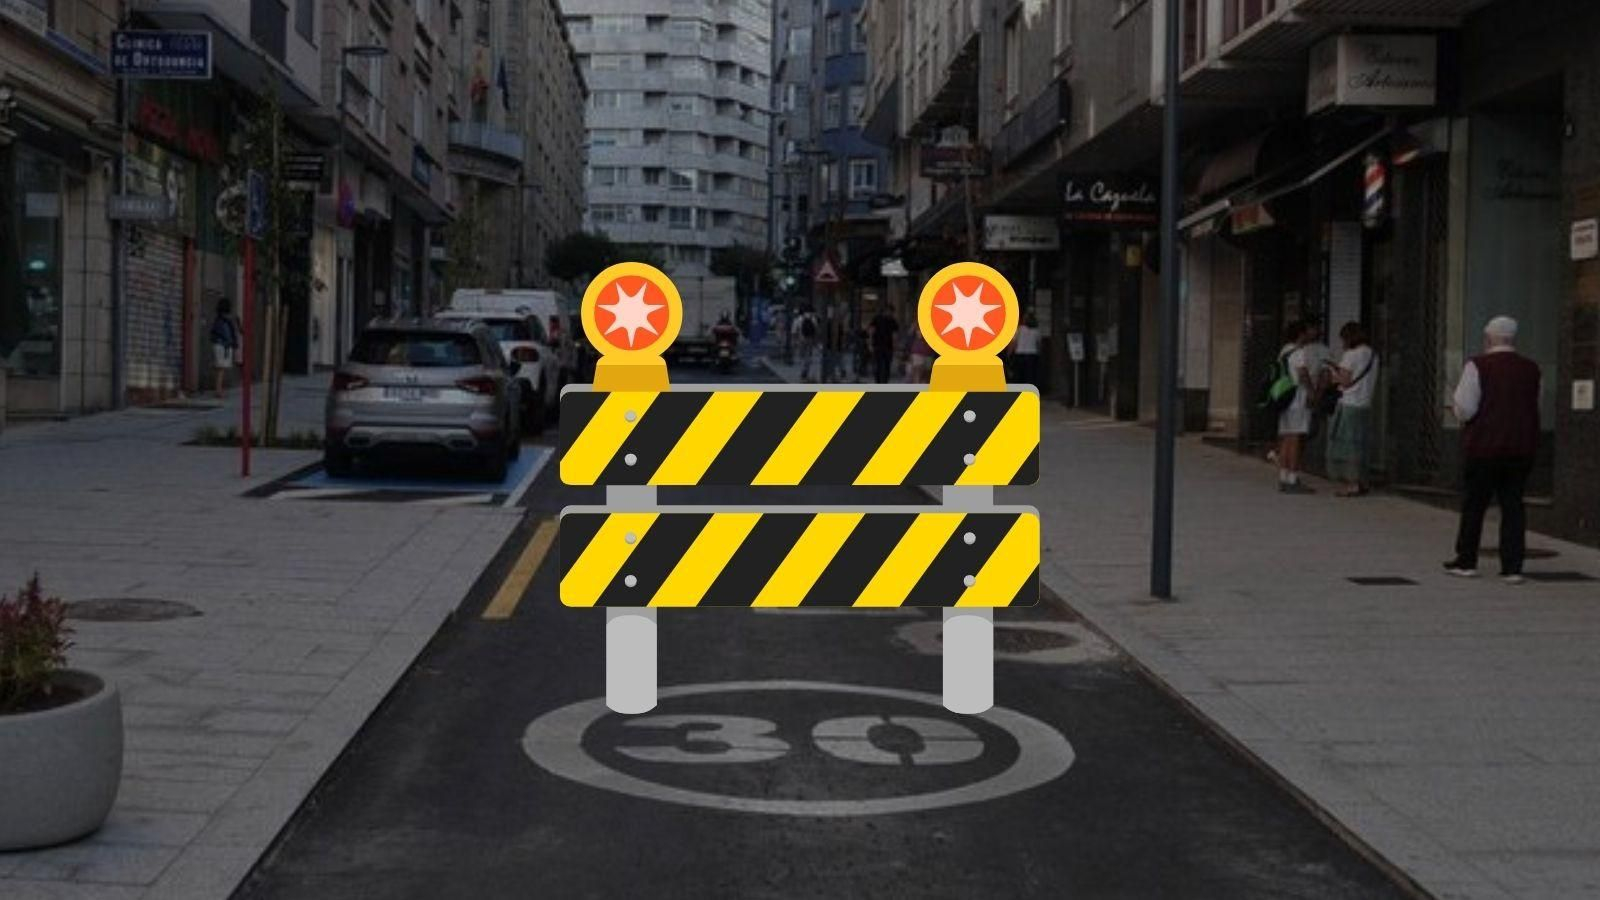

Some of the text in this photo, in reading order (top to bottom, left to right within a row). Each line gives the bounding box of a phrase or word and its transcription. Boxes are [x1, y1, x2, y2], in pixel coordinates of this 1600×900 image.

[1064, 181, 1157, 212] La Cazuela
[613, 714, 985, 766] 30
